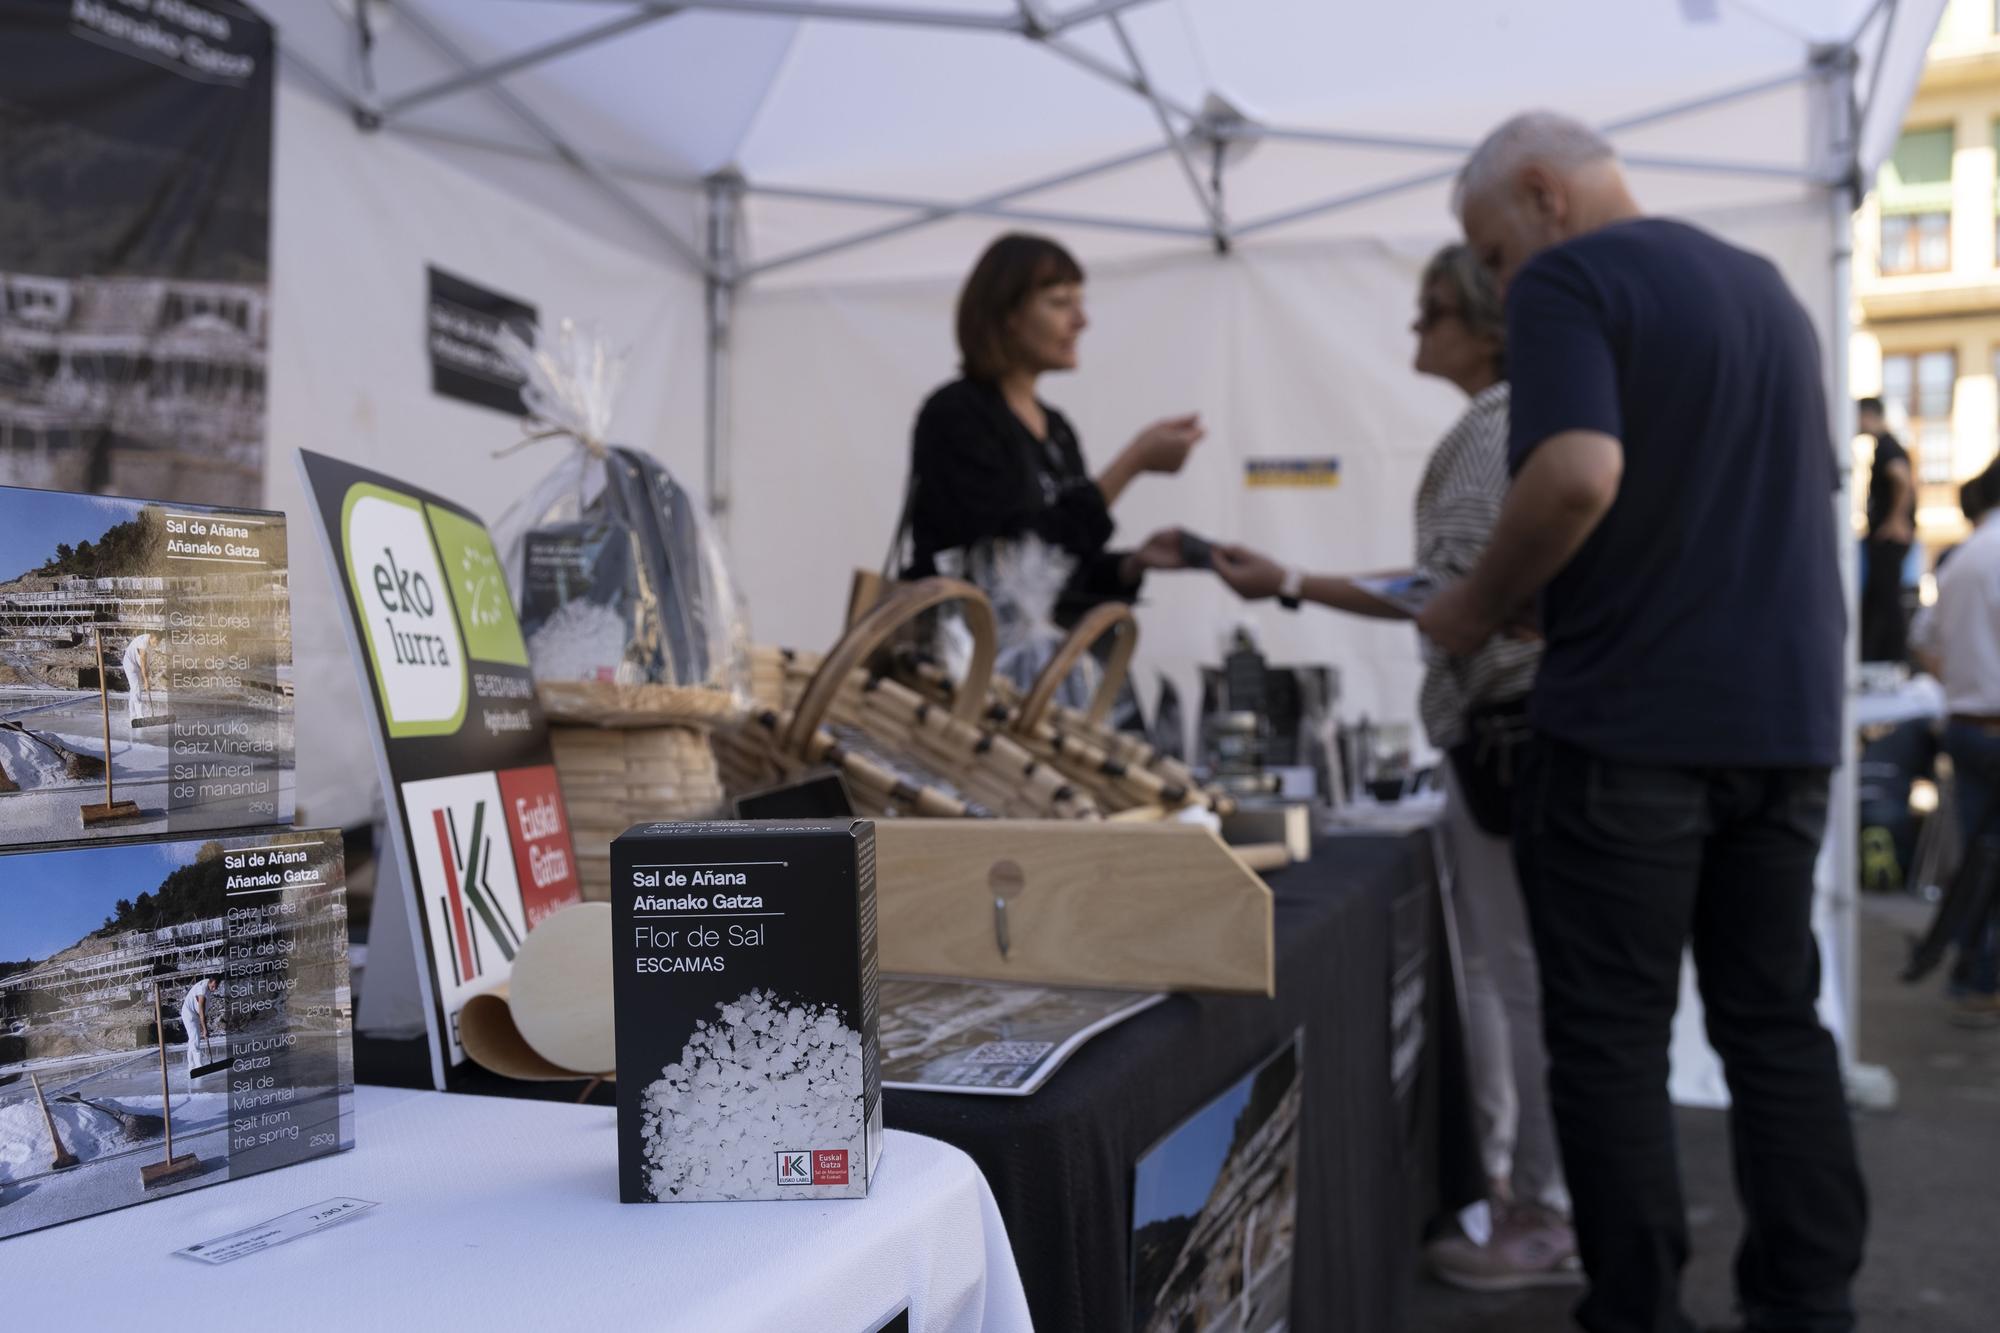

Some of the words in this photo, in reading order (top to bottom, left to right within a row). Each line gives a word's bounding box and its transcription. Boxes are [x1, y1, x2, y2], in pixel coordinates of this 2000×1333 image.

[166, 520, 187, 534] Sal
[190, 521, 207, 535] de
[209, 523, 249, 539] Añana
[167, 539, 222, 556] Añanako
[224, 543, 260, 558] Gatza
[373, 547, 435, 620] eko
[169, 611, 205, 627] Gatz
[209, 613, 251, 629] Lorea
[171, 630, 228, 646] Ezkatak
[385, 616, 451, 668] lurra
[172, 654, 200, 670] Flor
[204, 655, 225, 670] de
[228, 655, 251, 670] Sal
[173, 673, 242, 688] Escamas
[174, 720, 249, 737] Iturburuko
[173, 739, 210, 756] Gatz
[214, 738, 274, 753] Minerala
[174, 764, 197, 780] Sal
[202, 761, 254, 778] Mineral
[173, 783, 195, 798] de
[199, 778, 270, 797] manantial
[224, 854, 246, 869] Sal
[248, 853, 265, 867] de
[268, 850, 307, 865] Añana
[226, 871, 281, 889] Añanako
[283, 869, 319, 883] Gatza
[632, 871, 660, 888] Sal
[664, 870, 688, 887] de
[691, 870, 747, 886] Añana
[227, 907, 258, 921] Gatz
[261, 902, 297, 917] Lorea
[633, 894, 709, 911] Añanako
[712, 893, 763, 910] Gatza
[228, 919, 277, 938] Ezkatak
[635, 925, 679, 949] Flor
[687, 925, 720, 947] de
[728, 923, 764, 947] Sal
[229, 945, 253, 959] Flor
[256, 941, 275, 956] de
[277, 937, 297, 954] Sal
[229, 958, 290, 977] Escamas
[636, 956, 725, 973] ESCAMAS
[230, 982, 255, 998] Salt
[258, 977, 299, 994] Flower
[231, 998, 273, 1016] Flakes
[232, 1033, 297, 1056] Iturburuko
[232, 1056, 271, 1073] Gatza
[233, 1077, 253, 1094] Sal
[256, 1075, 275, 1089] de
[233, 1085, 295, 1111] Manantial
[234, 1116, 259, 1133] Salt
[261, 1110, 291, 1127] from
[234, 1135, 256, 1149] the
[259, 1125, 299, 1145] spring
[818, 1153, 842, 1161] Euskal
[820, 1161, 841, 1169] Gatza
